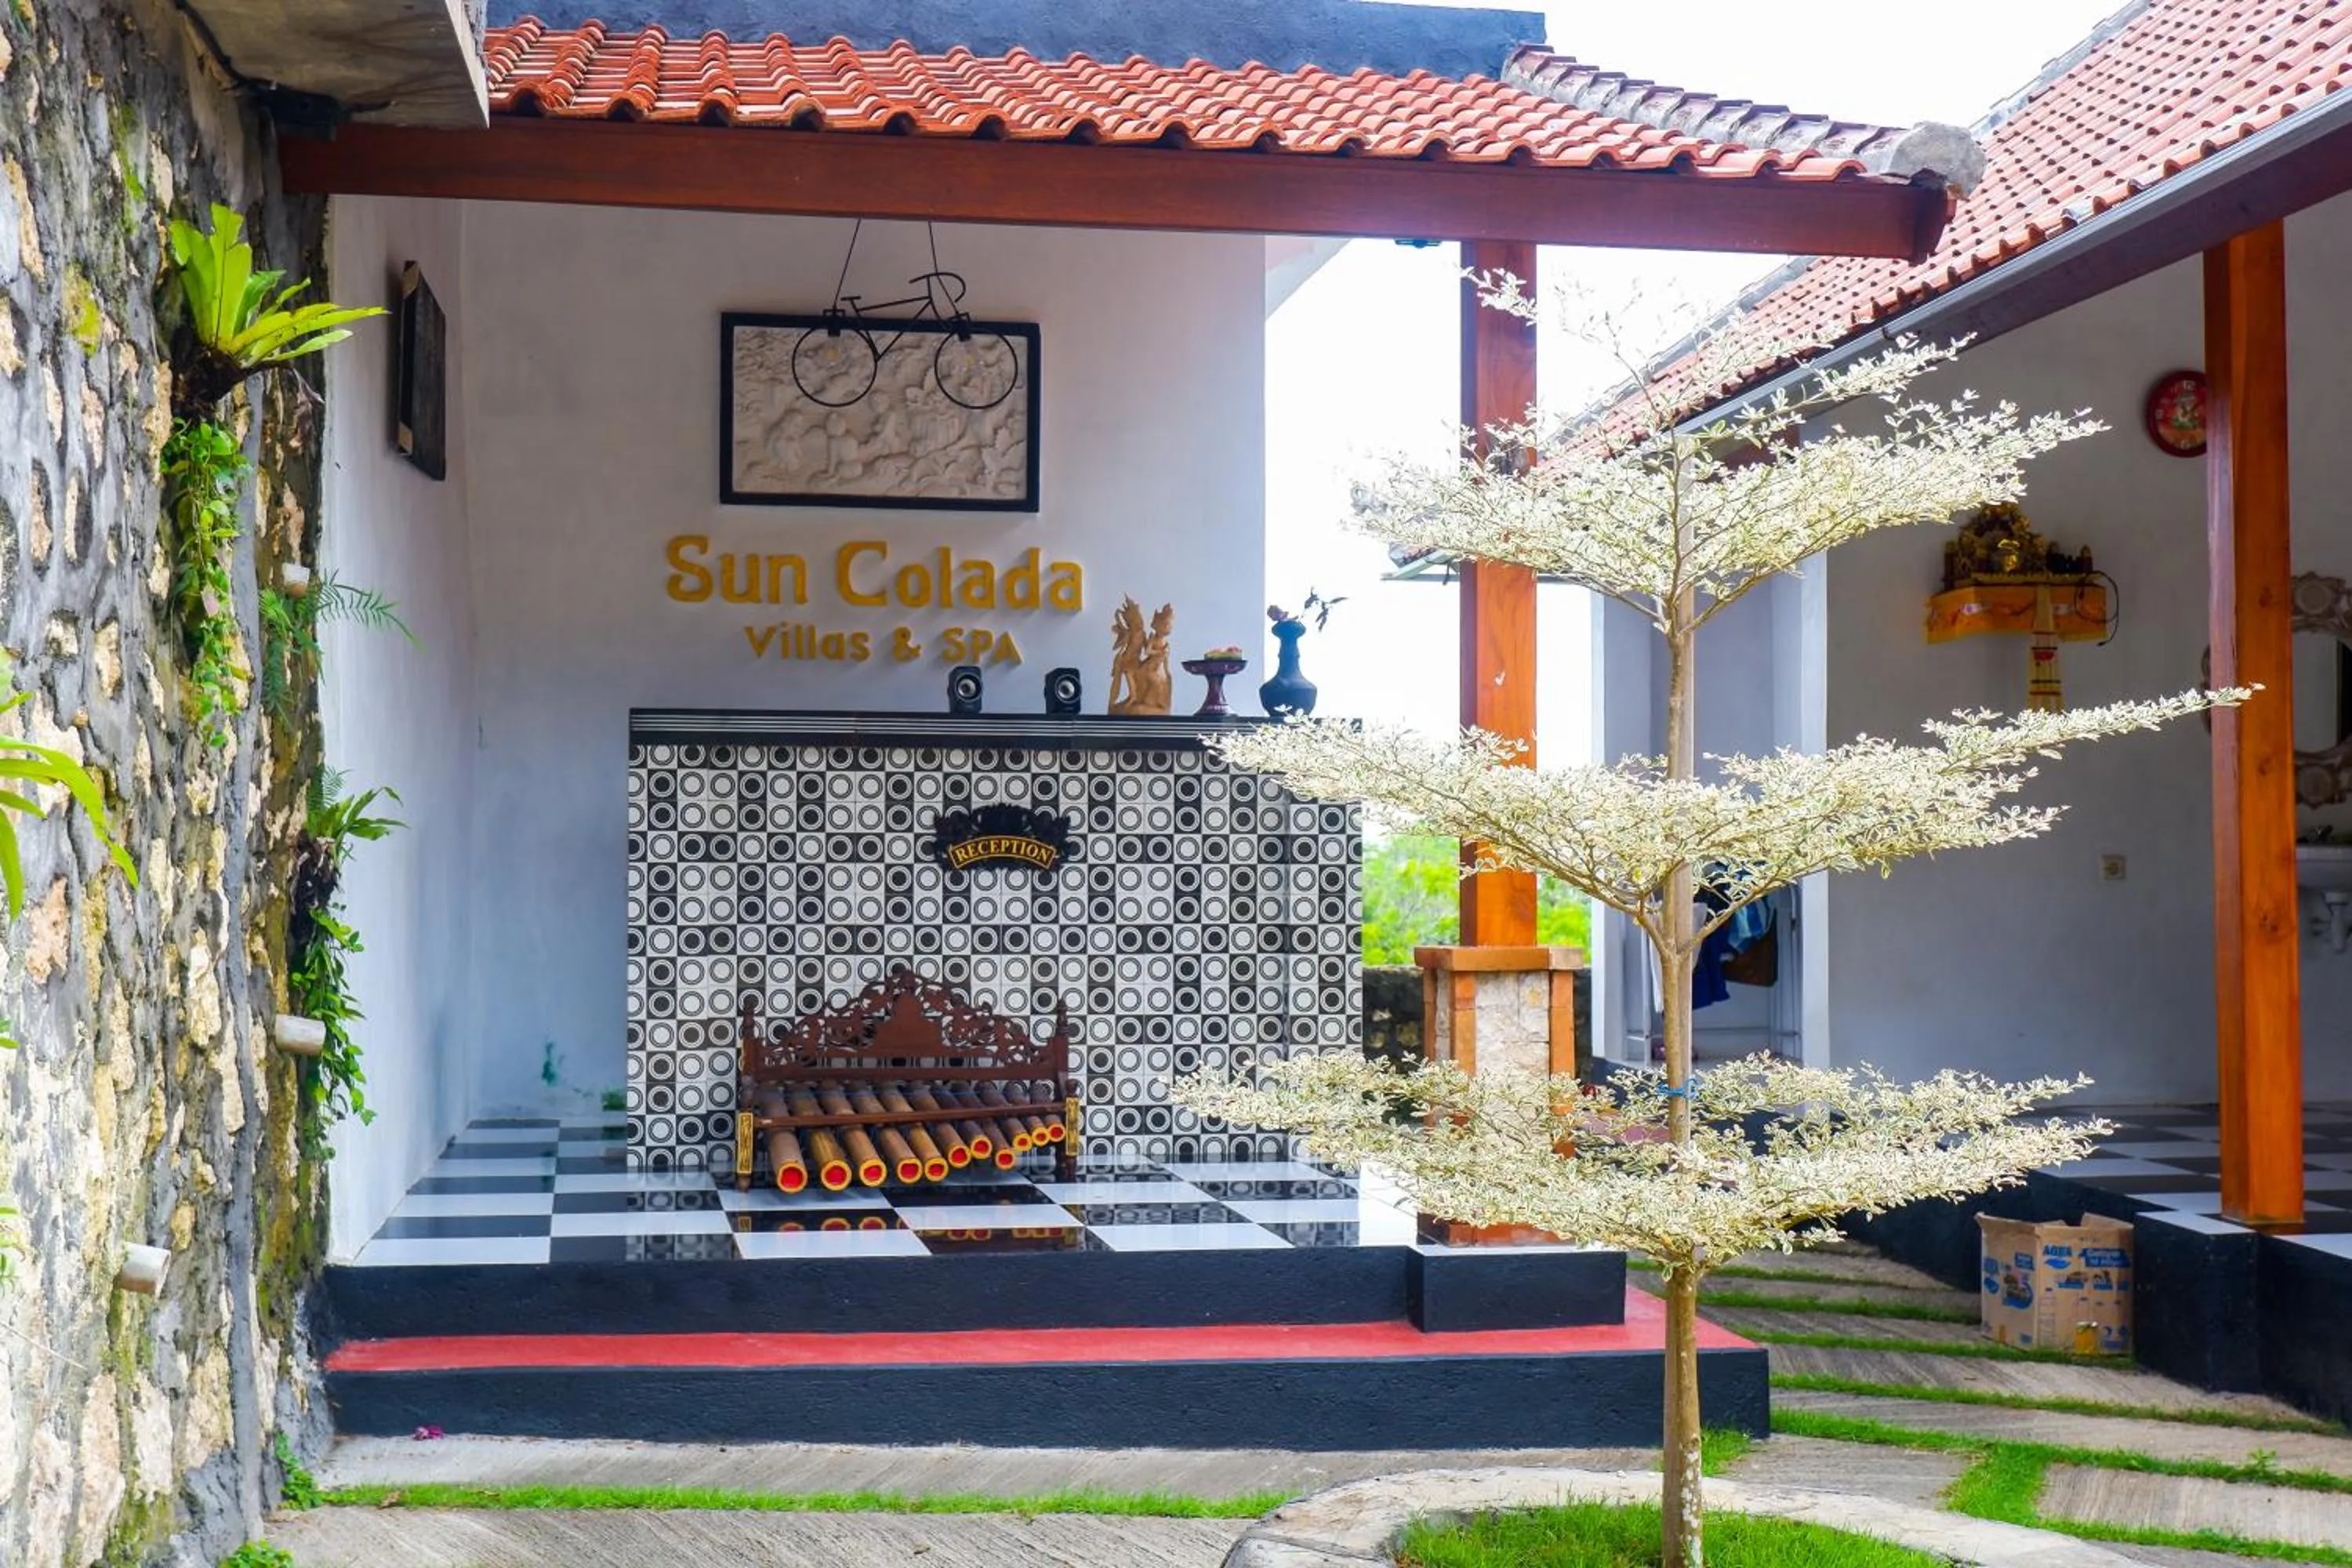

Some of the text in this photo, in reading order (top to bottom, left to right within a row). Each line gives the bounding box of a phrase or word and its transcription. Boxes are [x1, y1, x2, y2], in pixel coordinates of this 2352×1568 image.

[666, 534, 1083, 612] Sun Colada
[745, 622, 1022, 664] Villas & SPA
[955, 839, 1051, 862] RECEPTION
